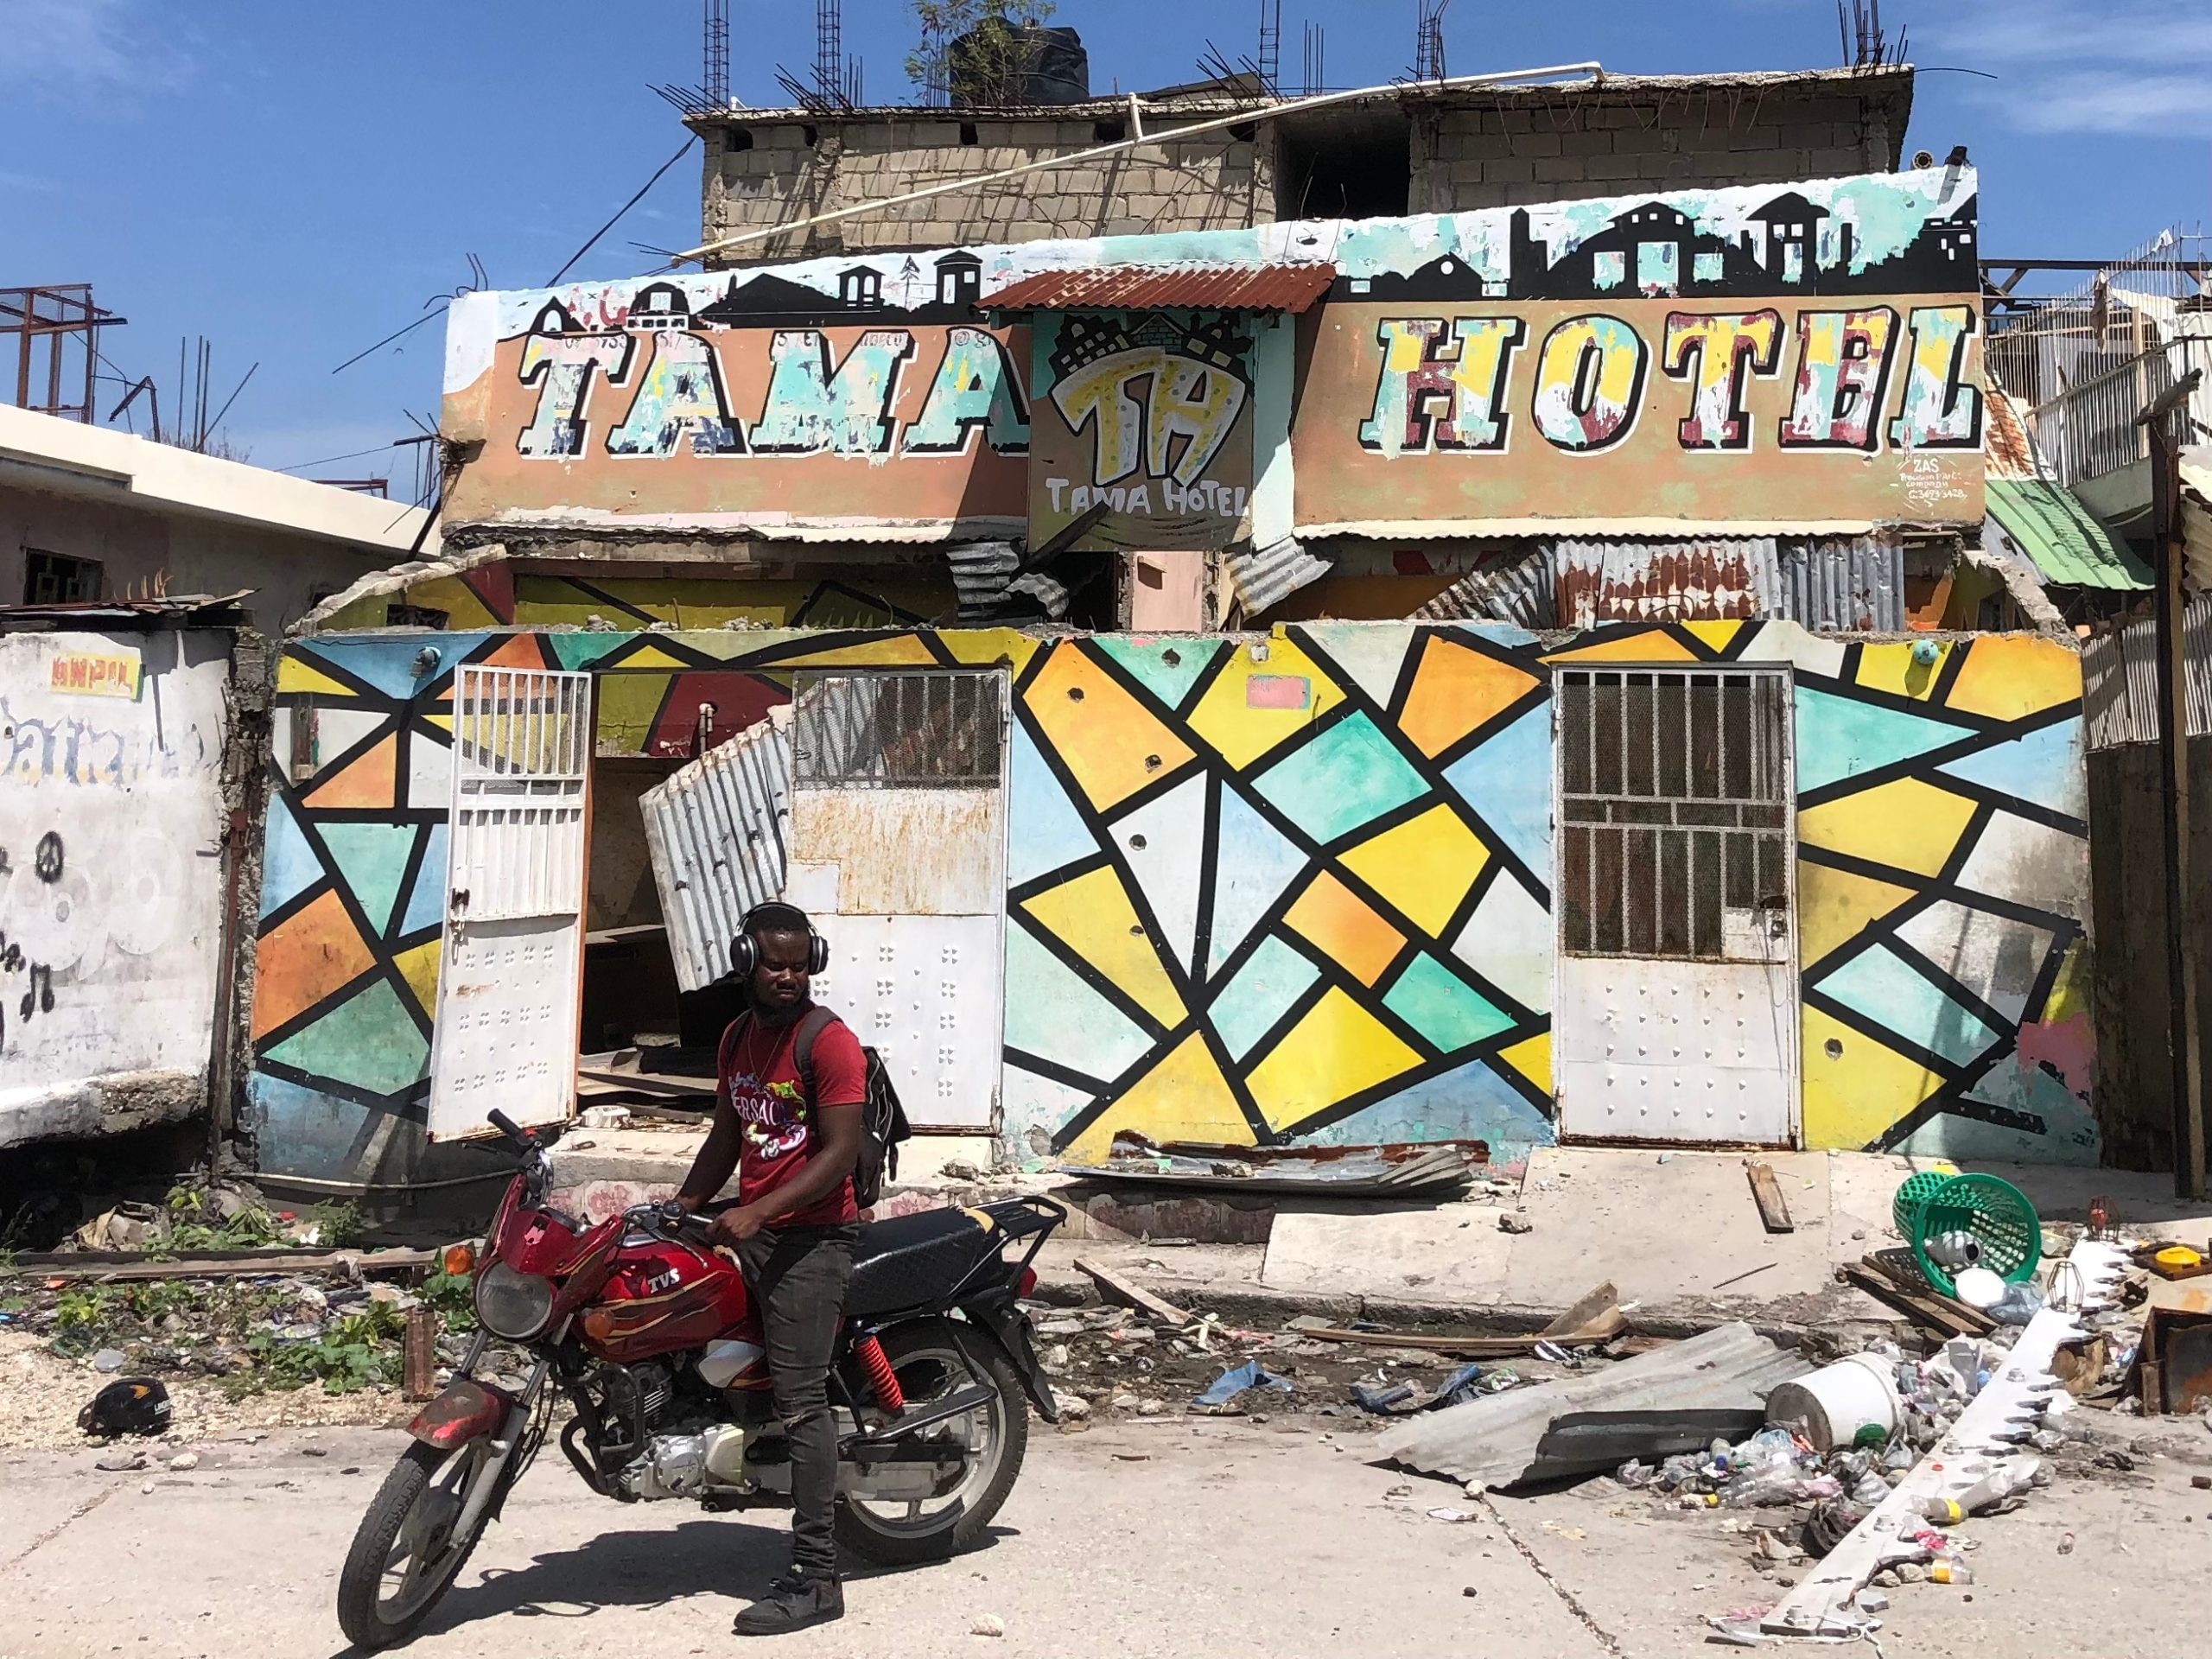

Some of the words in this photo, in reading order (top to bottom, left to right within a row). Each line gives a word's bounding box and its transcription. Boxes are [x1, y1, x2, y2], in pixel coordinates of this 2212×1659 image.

[517, 328, 1032, 459] TAMA
[1358, 305, 1987, 458] HOTEL
[1913, 457, 1940, 473] ZAS
[1046, 478, 1151, 514] TAMA
[1162, 477, 1249, 517] HOTEL
[647, 1267, 680, 1294] TVS
